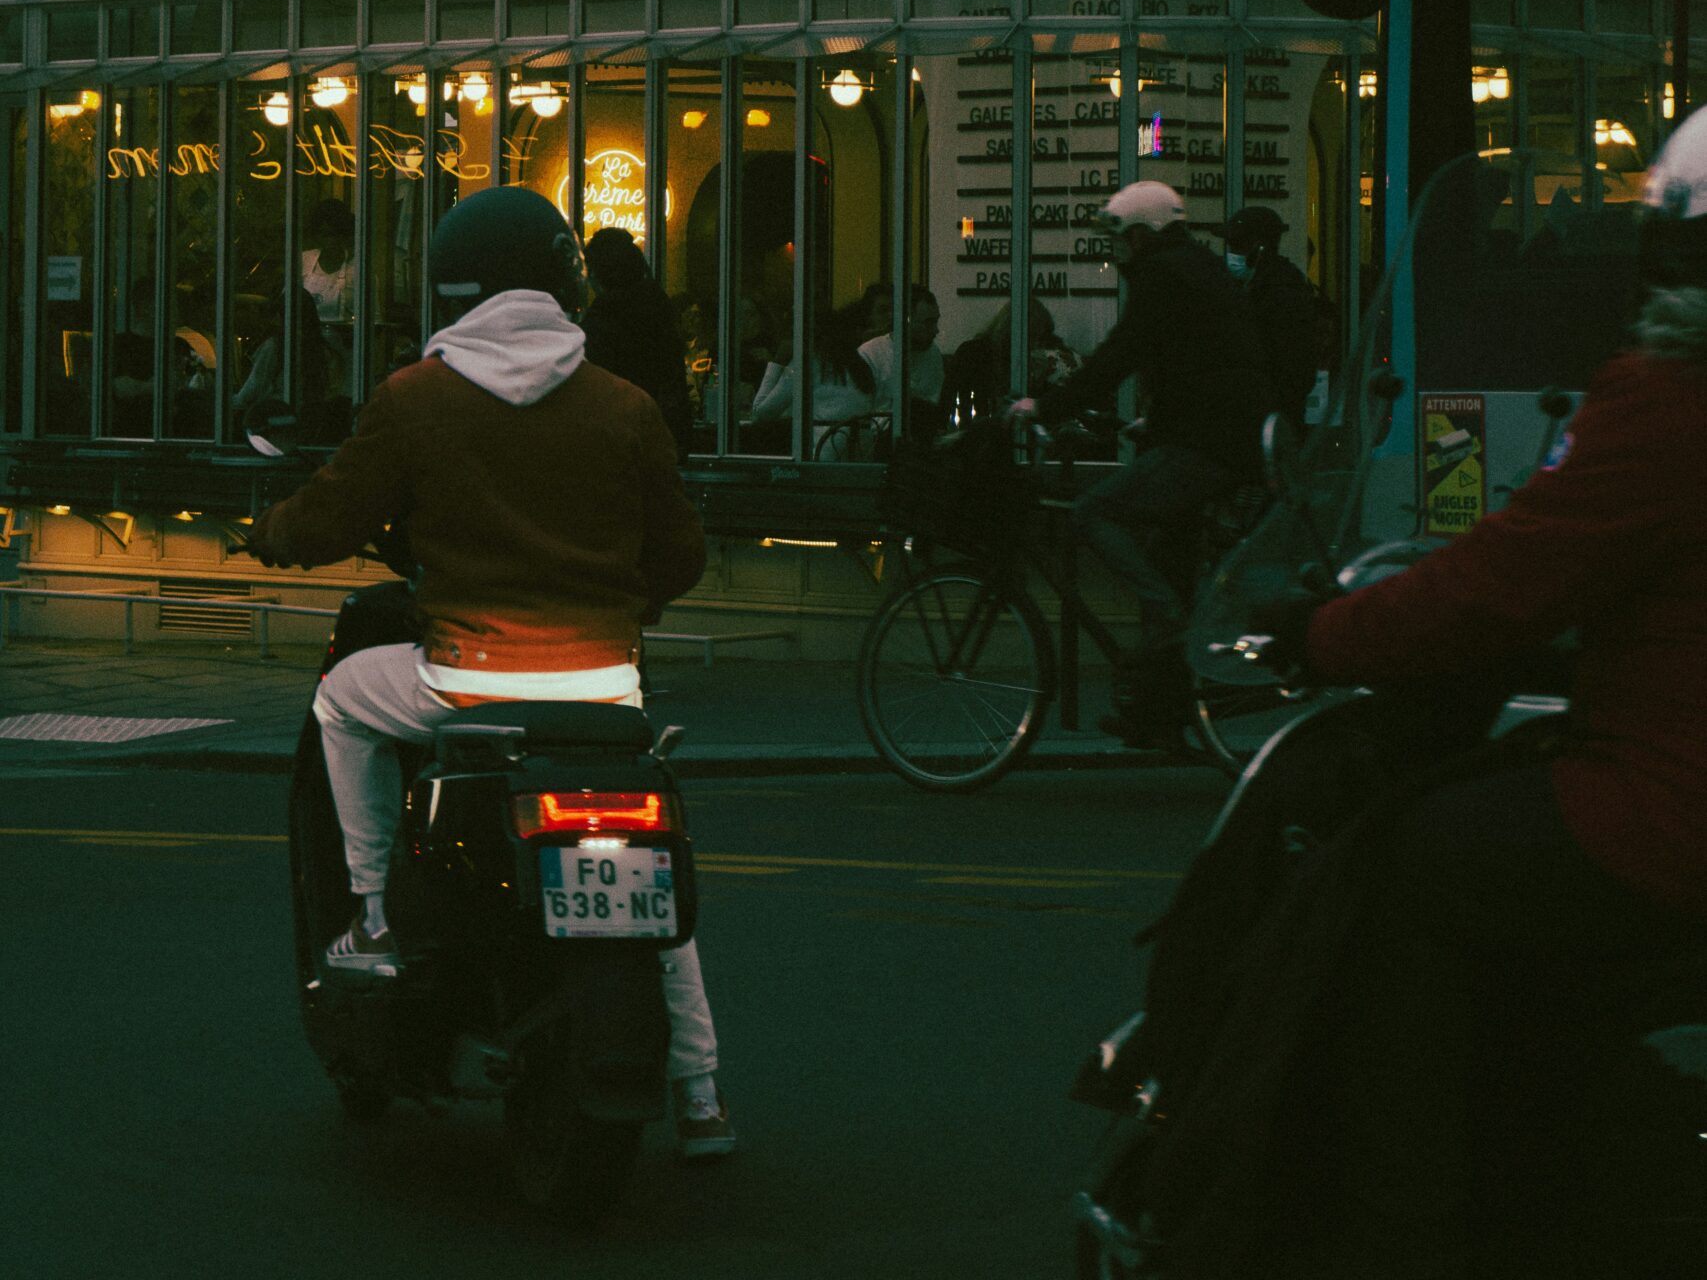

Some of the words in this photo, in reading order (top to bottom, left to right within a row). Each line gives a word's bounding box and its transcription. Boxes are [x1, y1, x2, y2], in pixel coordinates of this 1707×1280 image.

[1425, 398, 1481, 411] ATTENTION
[1433, 495, 1478, 510] ANGLES
[551, 891, 669, 919] 638-NC
